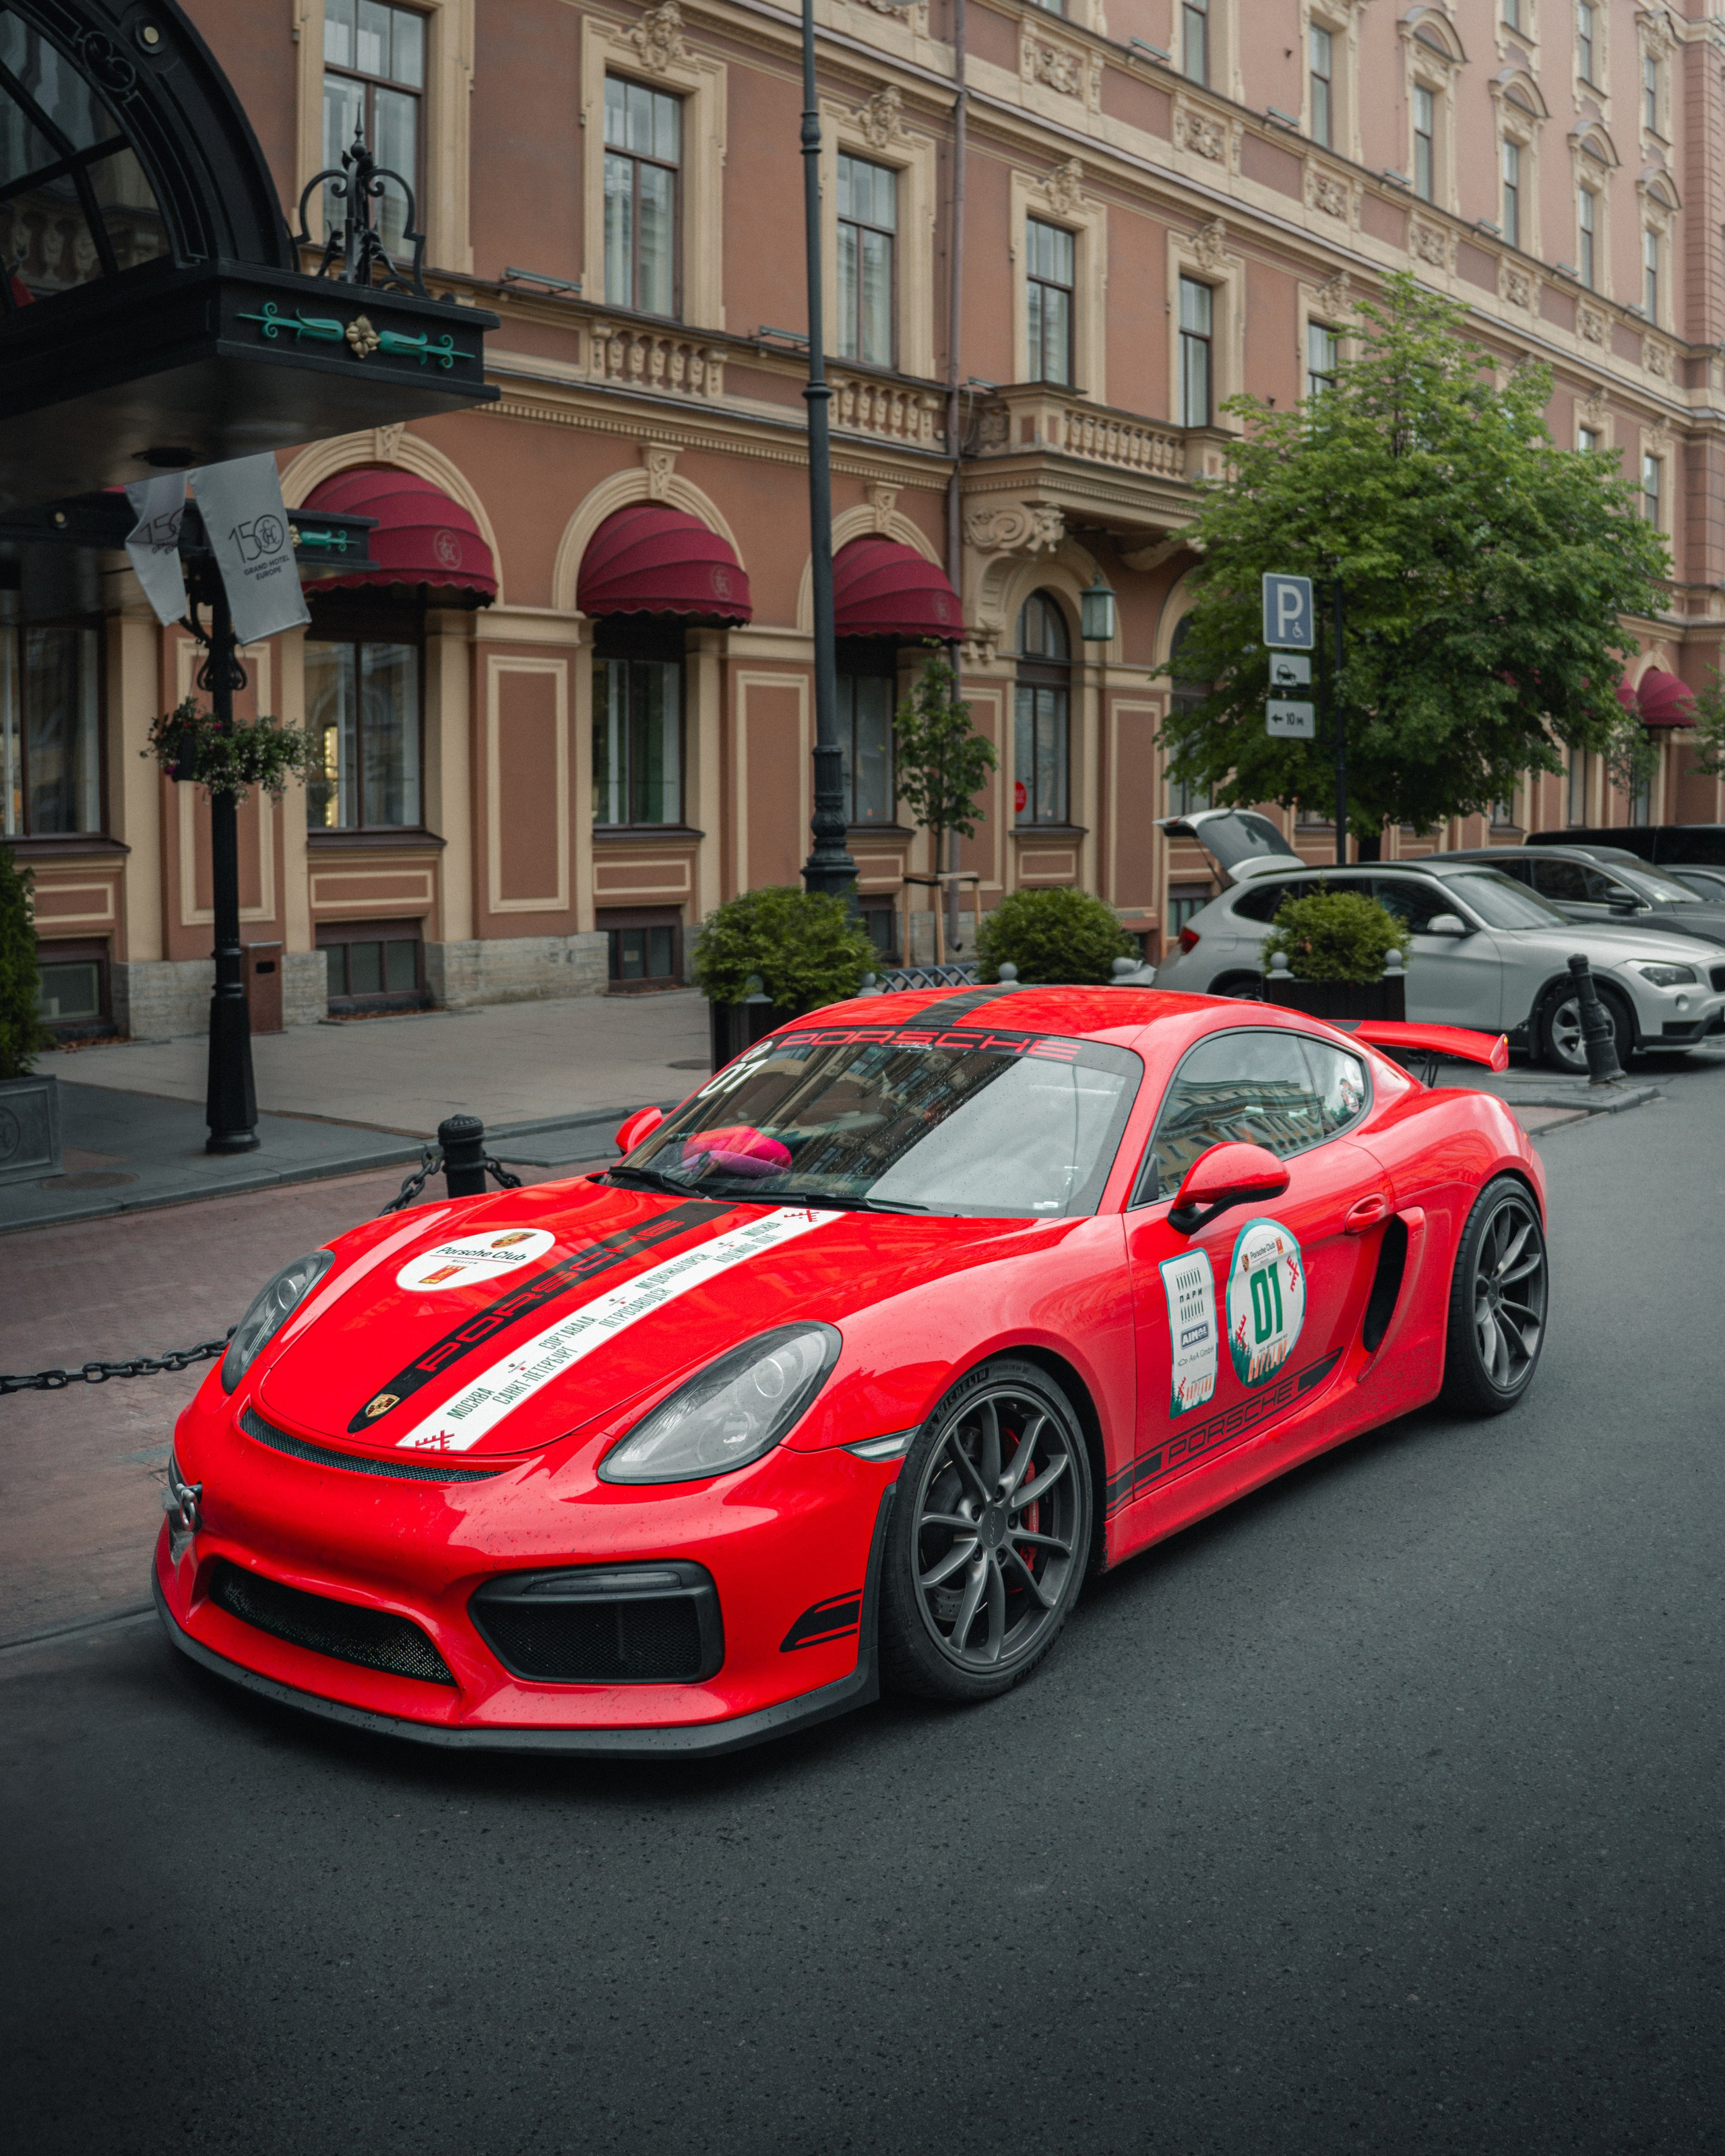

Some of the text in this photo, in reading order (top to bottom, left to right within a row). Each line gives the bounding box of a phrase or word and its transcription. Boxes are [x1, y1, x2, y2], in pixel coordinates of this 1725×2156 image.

[228, 514, 284, 564] 150
[244, 554, 290, 576] GRAND HOTEL
[256, 565, 282, 581] EUROPE
[1277, 583, 1303, 638] P
[1286, 712, 1295, 726] 10
[776, 1030, 1083, 1061] PORSCHE
[697, 1058, 769, 1099] 01
[741, 1221, 784, 1237] МОСКВА
[435, 1246, 528, 1261] Porsche Club
[712, 1242, 761, 1264] ЛОДЕЙНОЕ
[751, 1234, 782, 1247] ПОЛЕ
[1249, 1241, 1276, 1260] Porsche Club
[635, 1253, 713, 1290] МЕДВЕЖЬЕГОРСК
[415, 1219, 685, 1372] PORSCHE
[598, 1288, 673, 1328] ПЕТРОЗАВОДСК
[1179, 1290, 1203, 1303] ПАРИ
[1249, 1261, 1283, 1345] 01
[538, 1315, 599, 1350] СОРТАВАЛА
[1189, 1345, 1214, 1363] AvA GmbH
[492, 1345, 578, 1405] САНКТ-ПЕТЕРБУРГ
[446, 1387, 495, 1420] МОСКВА
[937, 1368, 988, 1420] MICHELIN
[1168, 1380, 1294, 1465] PORSCHE
